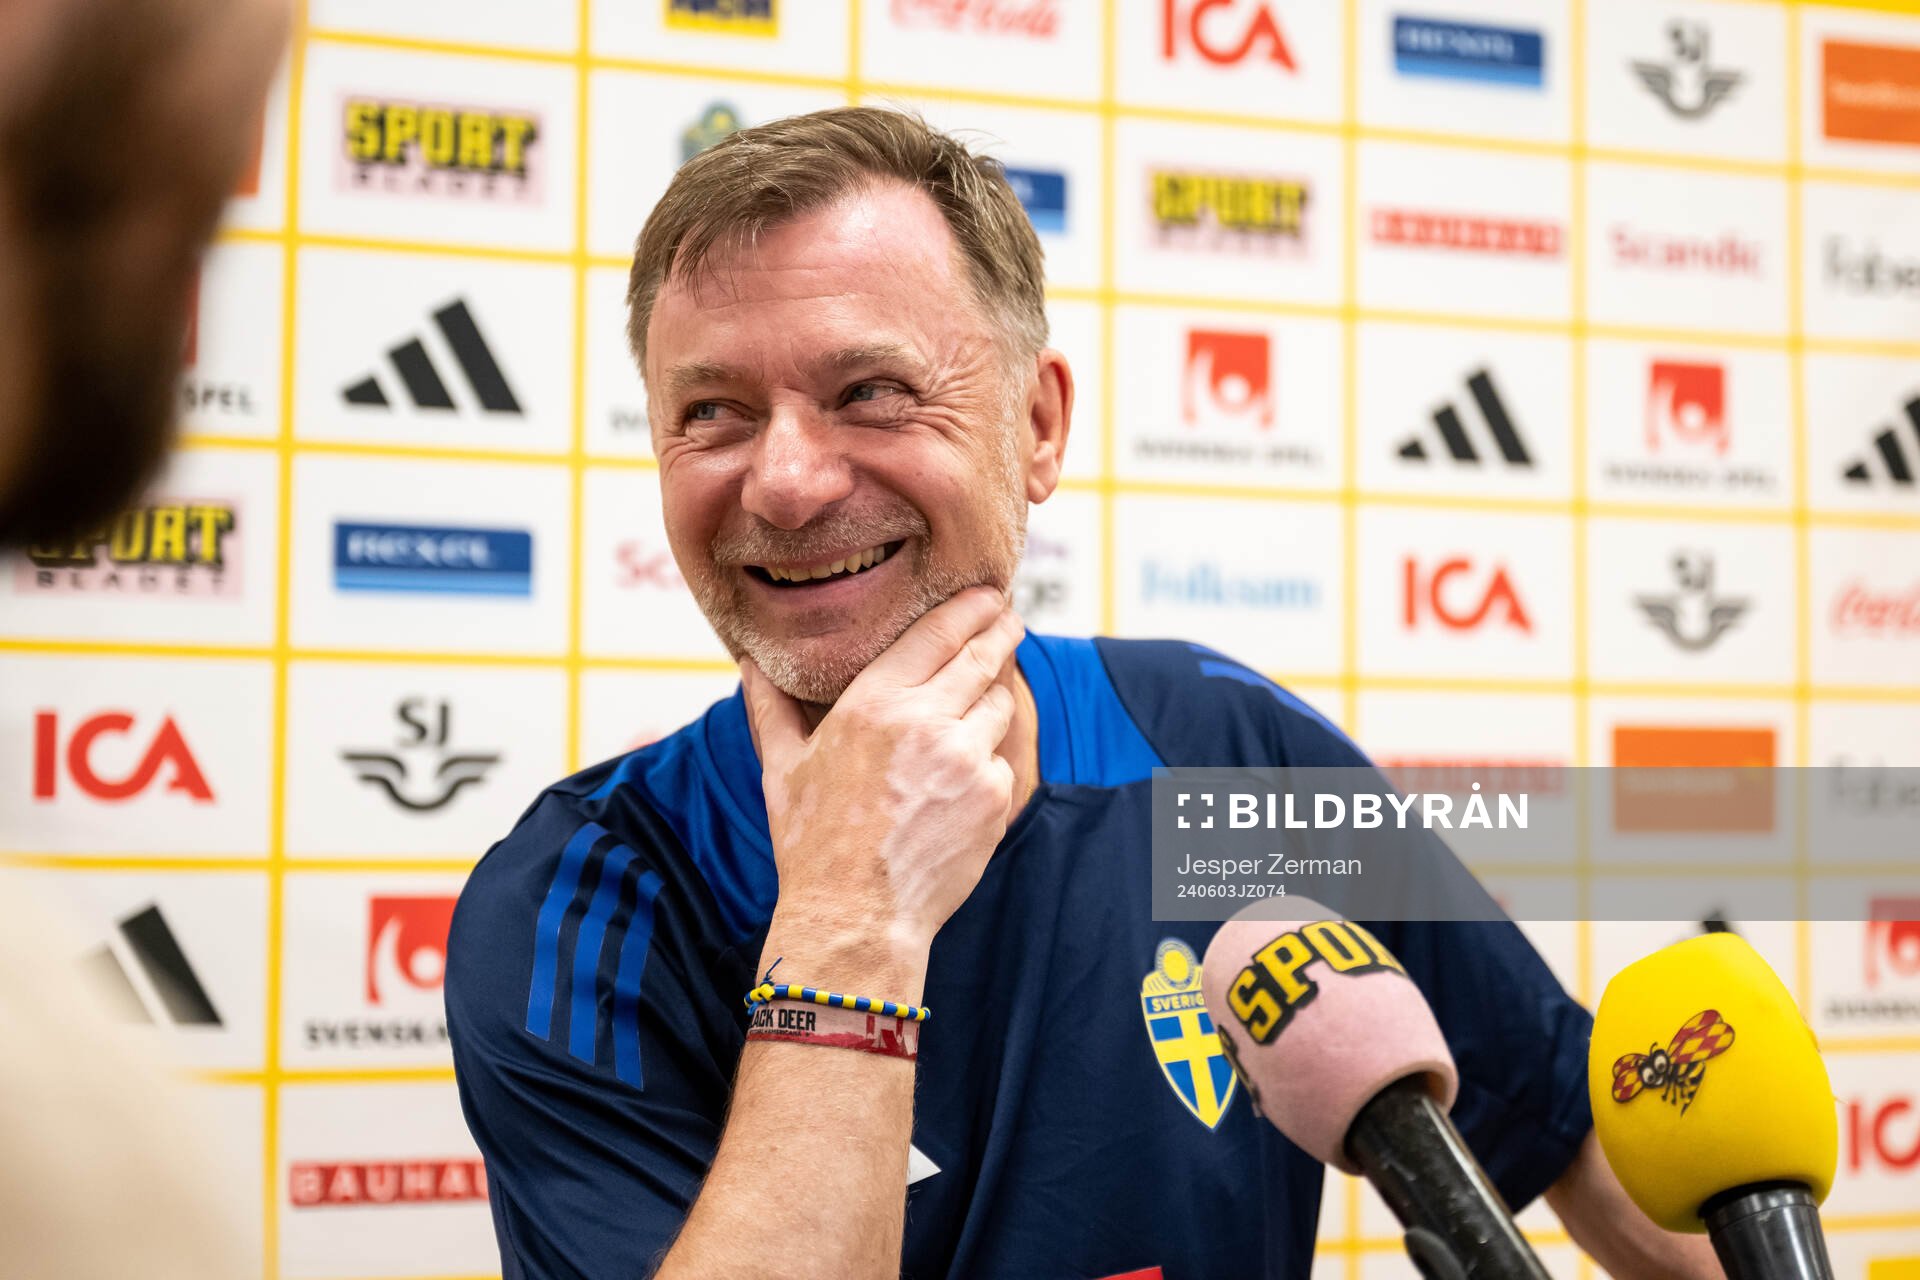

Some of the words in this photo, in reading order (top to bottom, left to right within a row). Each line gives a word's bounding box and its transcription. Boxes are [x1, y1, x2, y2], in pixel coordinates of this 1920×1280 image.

[346, 99, 536, 178] SPORT
[27, 504, 234, 571] ORT
[1403, 554, 1532, 634] ICA
[33, 709, 217, 803] ICA
[397, 699, 453, 747] SJ
[752, 1008, 774, 1028] ACK
[778, 1009, 817, 1032] DEER
